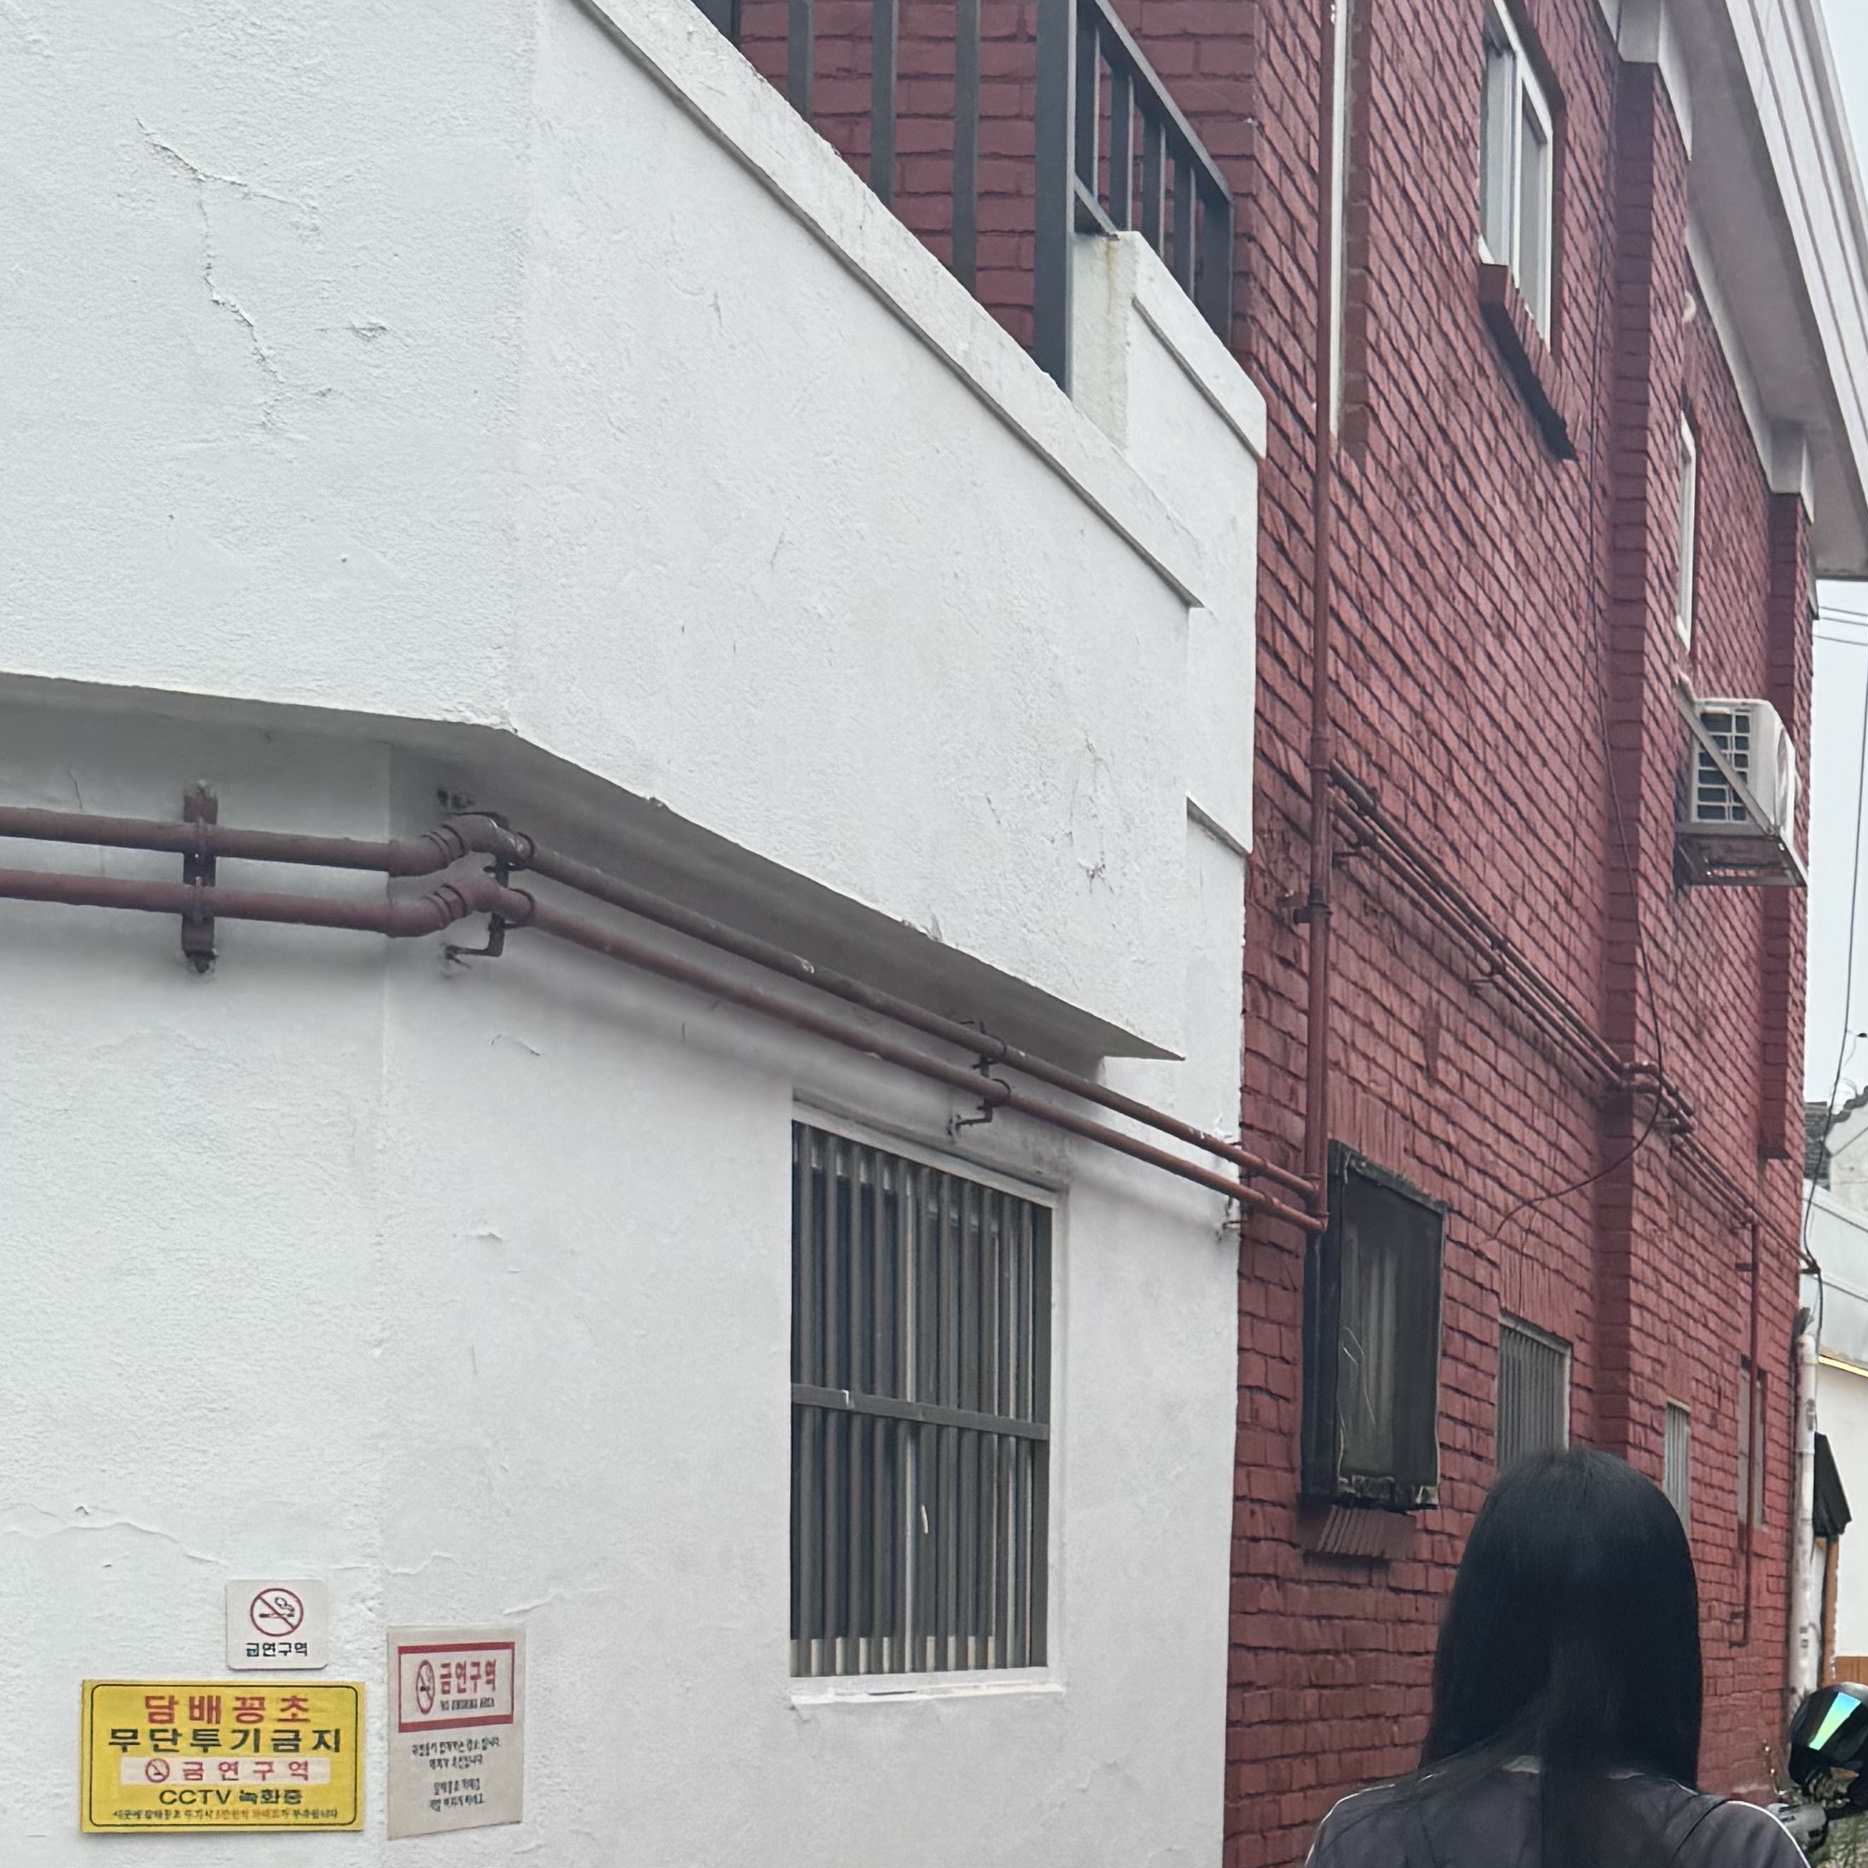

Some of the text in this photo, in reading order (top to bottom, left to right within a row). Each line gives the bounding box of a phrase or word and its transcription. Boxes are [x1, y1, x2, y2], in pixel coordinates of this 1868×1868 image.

[245, 1641, 308, 1657] 금연구역
[439, 1659, 497, 1695] 금연구역
[144, 1695, 311, 1725] 담배꽁초
[108, 1728, 342, 1753] 무단투기금지
[182, 1761, 309, 1782] 금연구역
[159, 1789, 303, 1805] CCTV 녹화중
